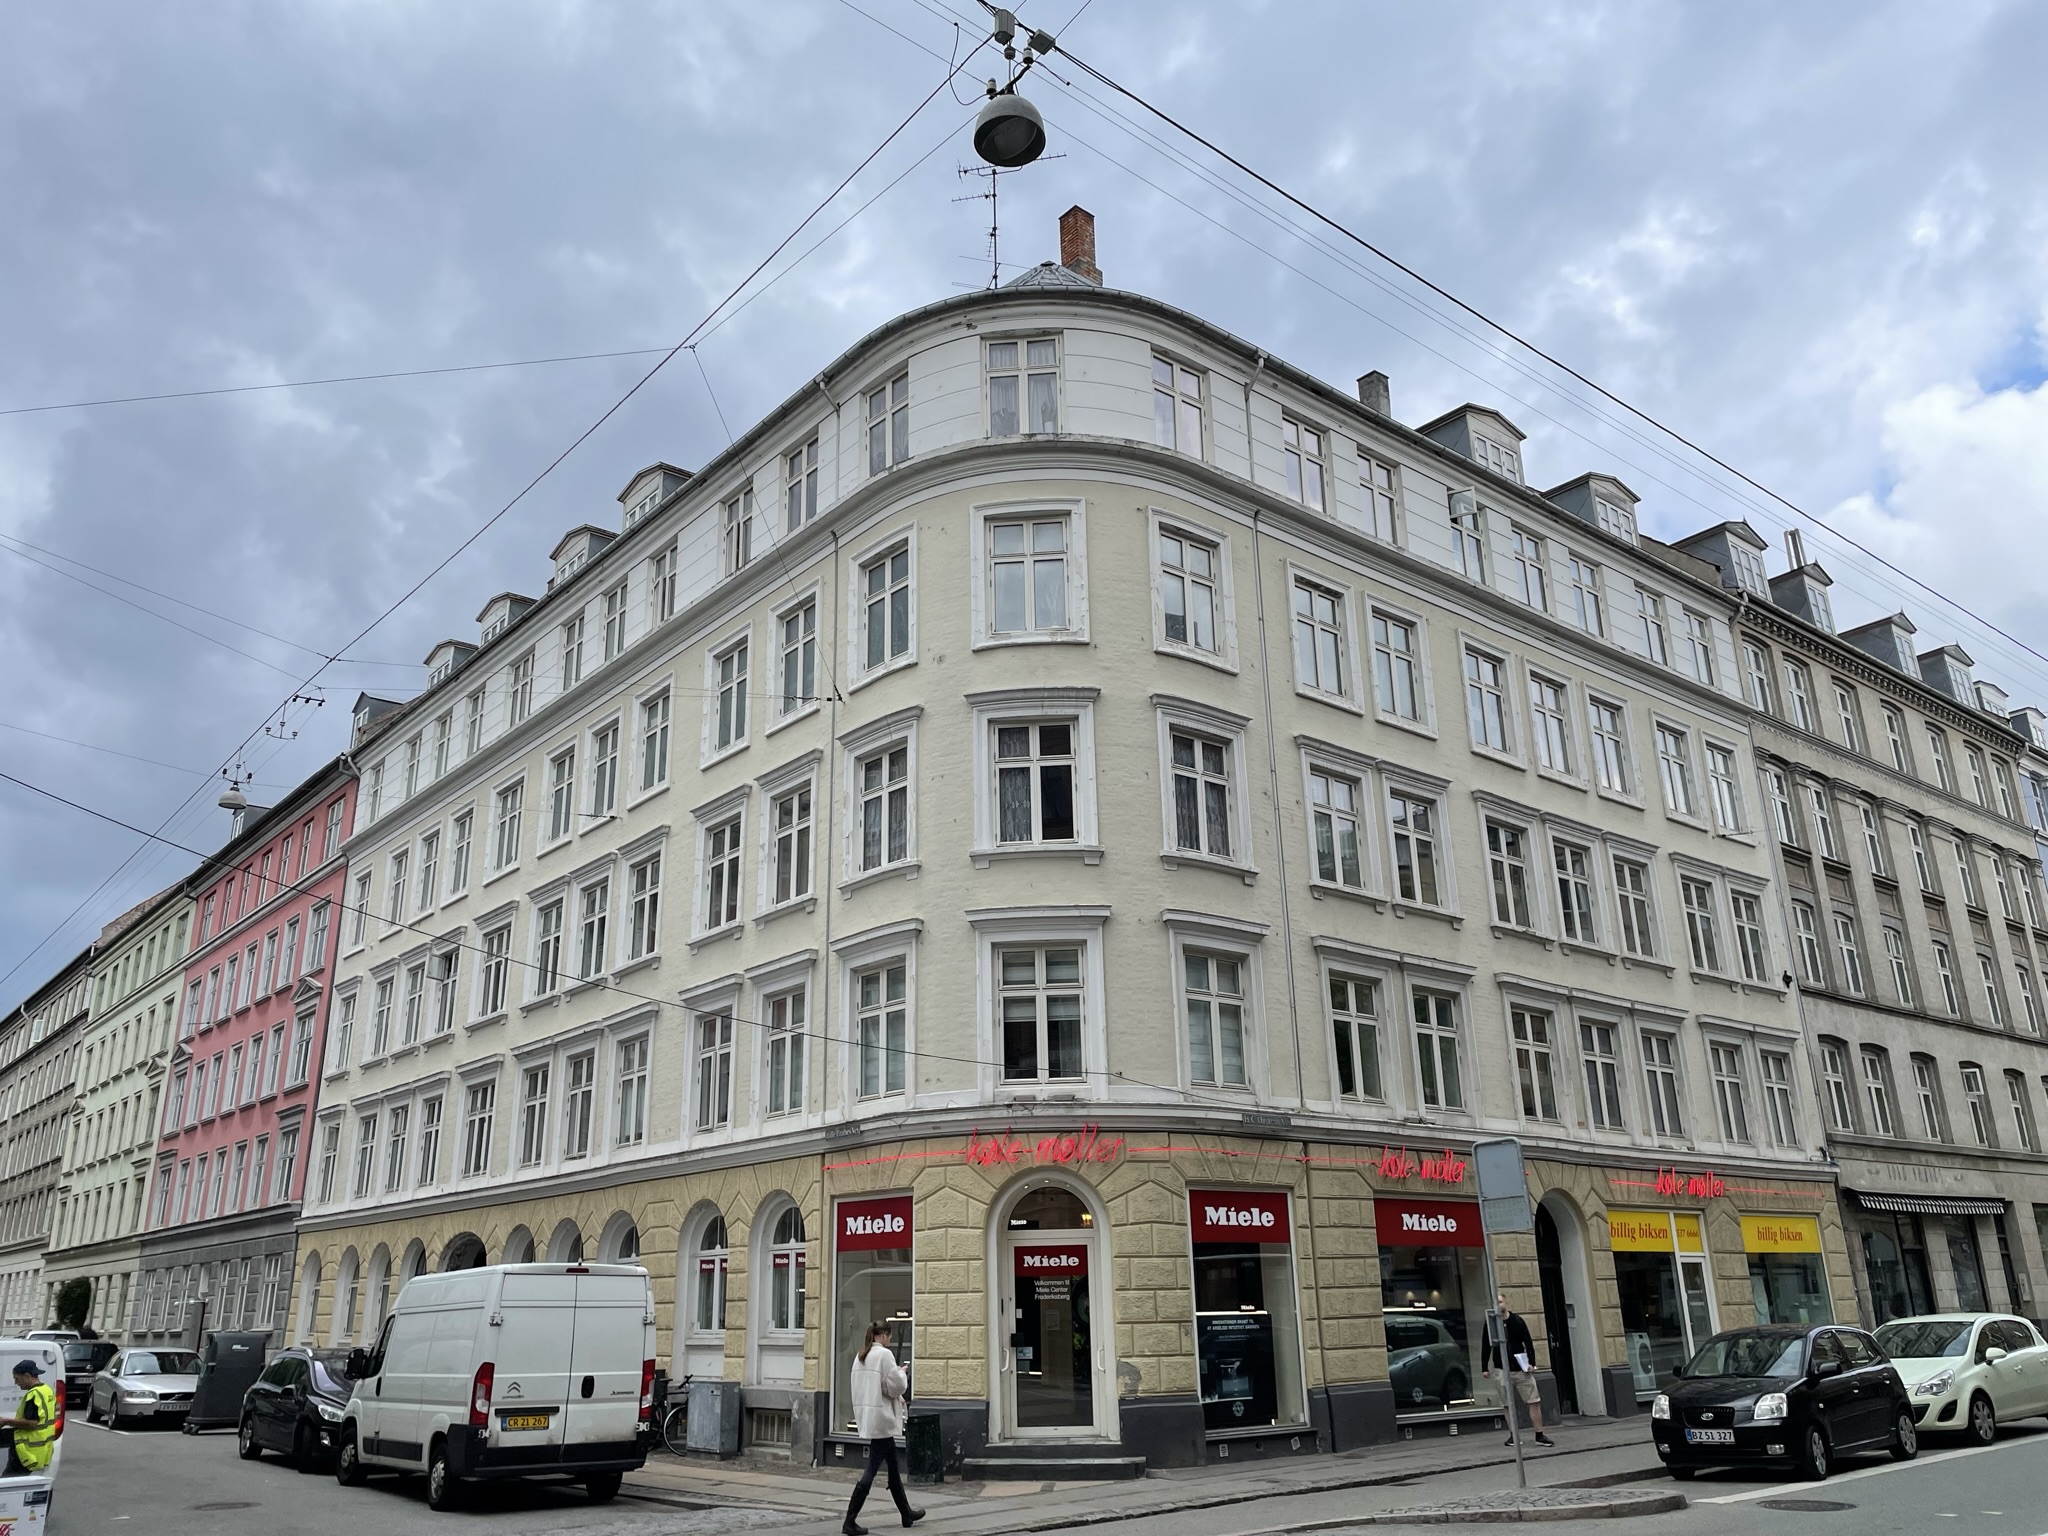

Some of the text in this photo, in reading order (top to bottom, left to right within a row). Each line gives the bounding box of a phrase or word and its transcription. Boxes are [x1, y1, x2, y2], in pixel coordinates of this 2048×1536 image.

[846, 1214, 905, 1235] Miele
[1204, 1206, 1275, 1227] Miele
[1401, 1213, 1457, 1232] Miele
[1610, 1222, 1668, 1243] billig biksen
[1757, 1226, 1803, 1244] billig biksen
[1023, 1255, 1080, 1267] Miele
[507, 1417, 547, 1427] CR 21 267
[1692, 1431, 1732, 1440] BZ 51 327
